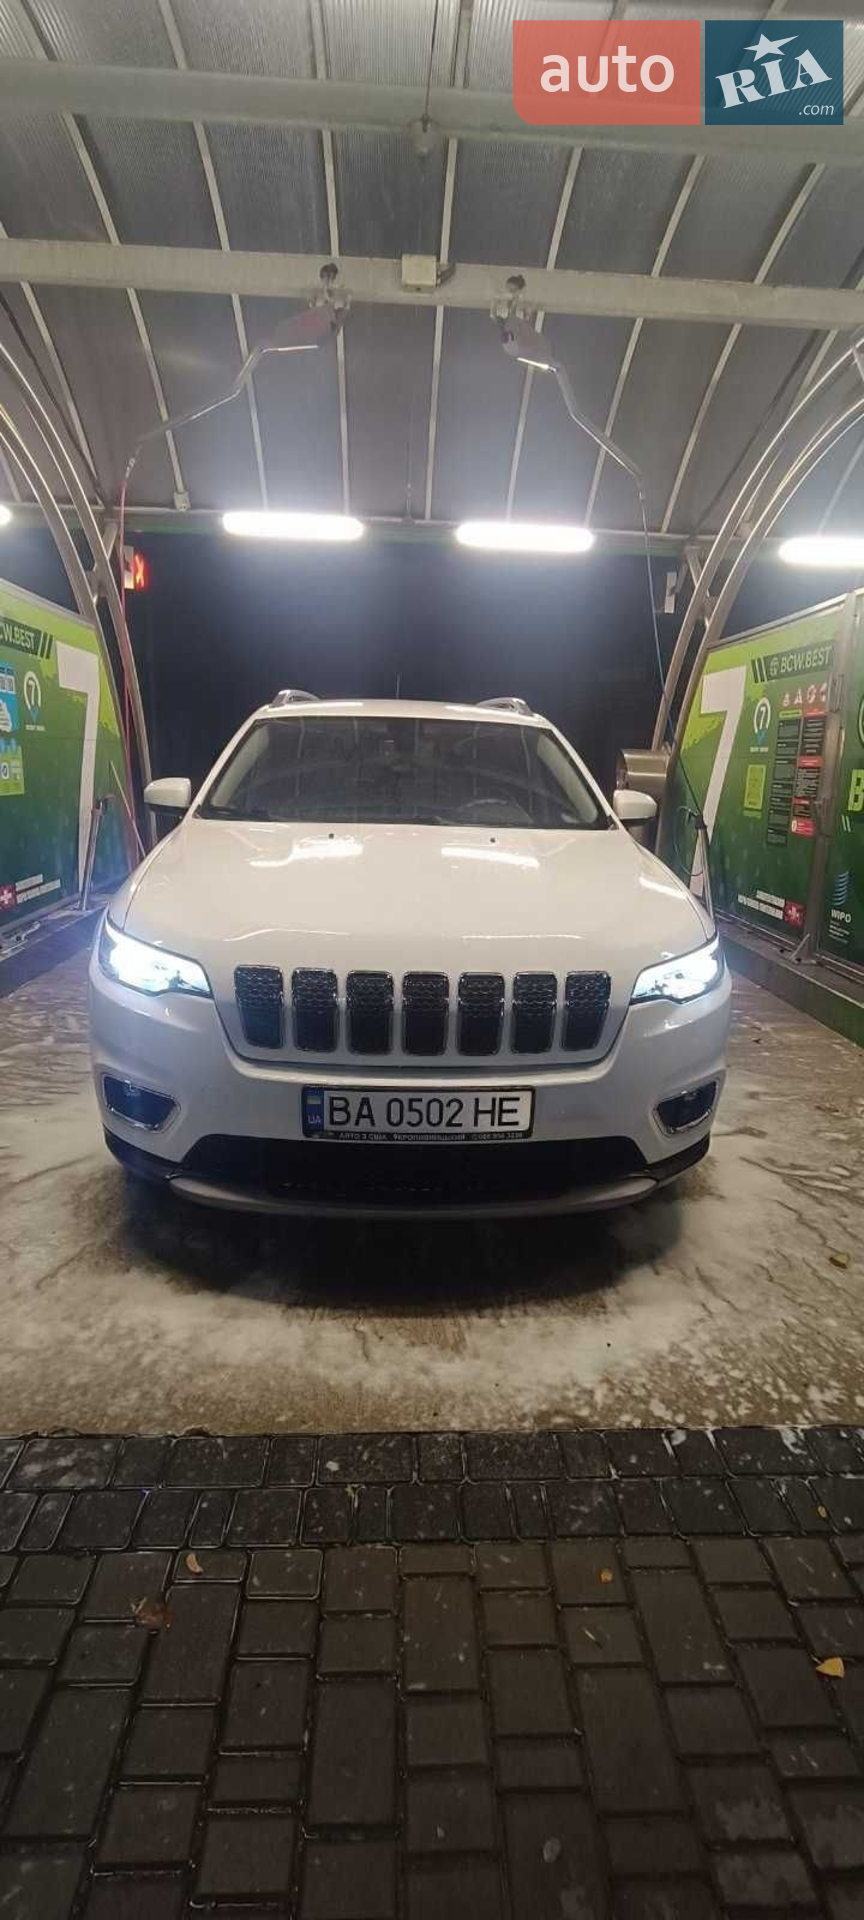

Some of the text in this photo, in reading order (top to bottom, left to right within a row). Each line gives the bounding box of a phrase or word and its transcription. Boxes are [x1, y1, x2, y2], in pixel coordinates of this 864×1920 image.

[780, 646, 832, 673] BCW.BEST
[55, 640, 100, 894] 7
[691, 665, 747, 897] 7
[307, 1097, 521, 1127] UA BA 0502 HE
